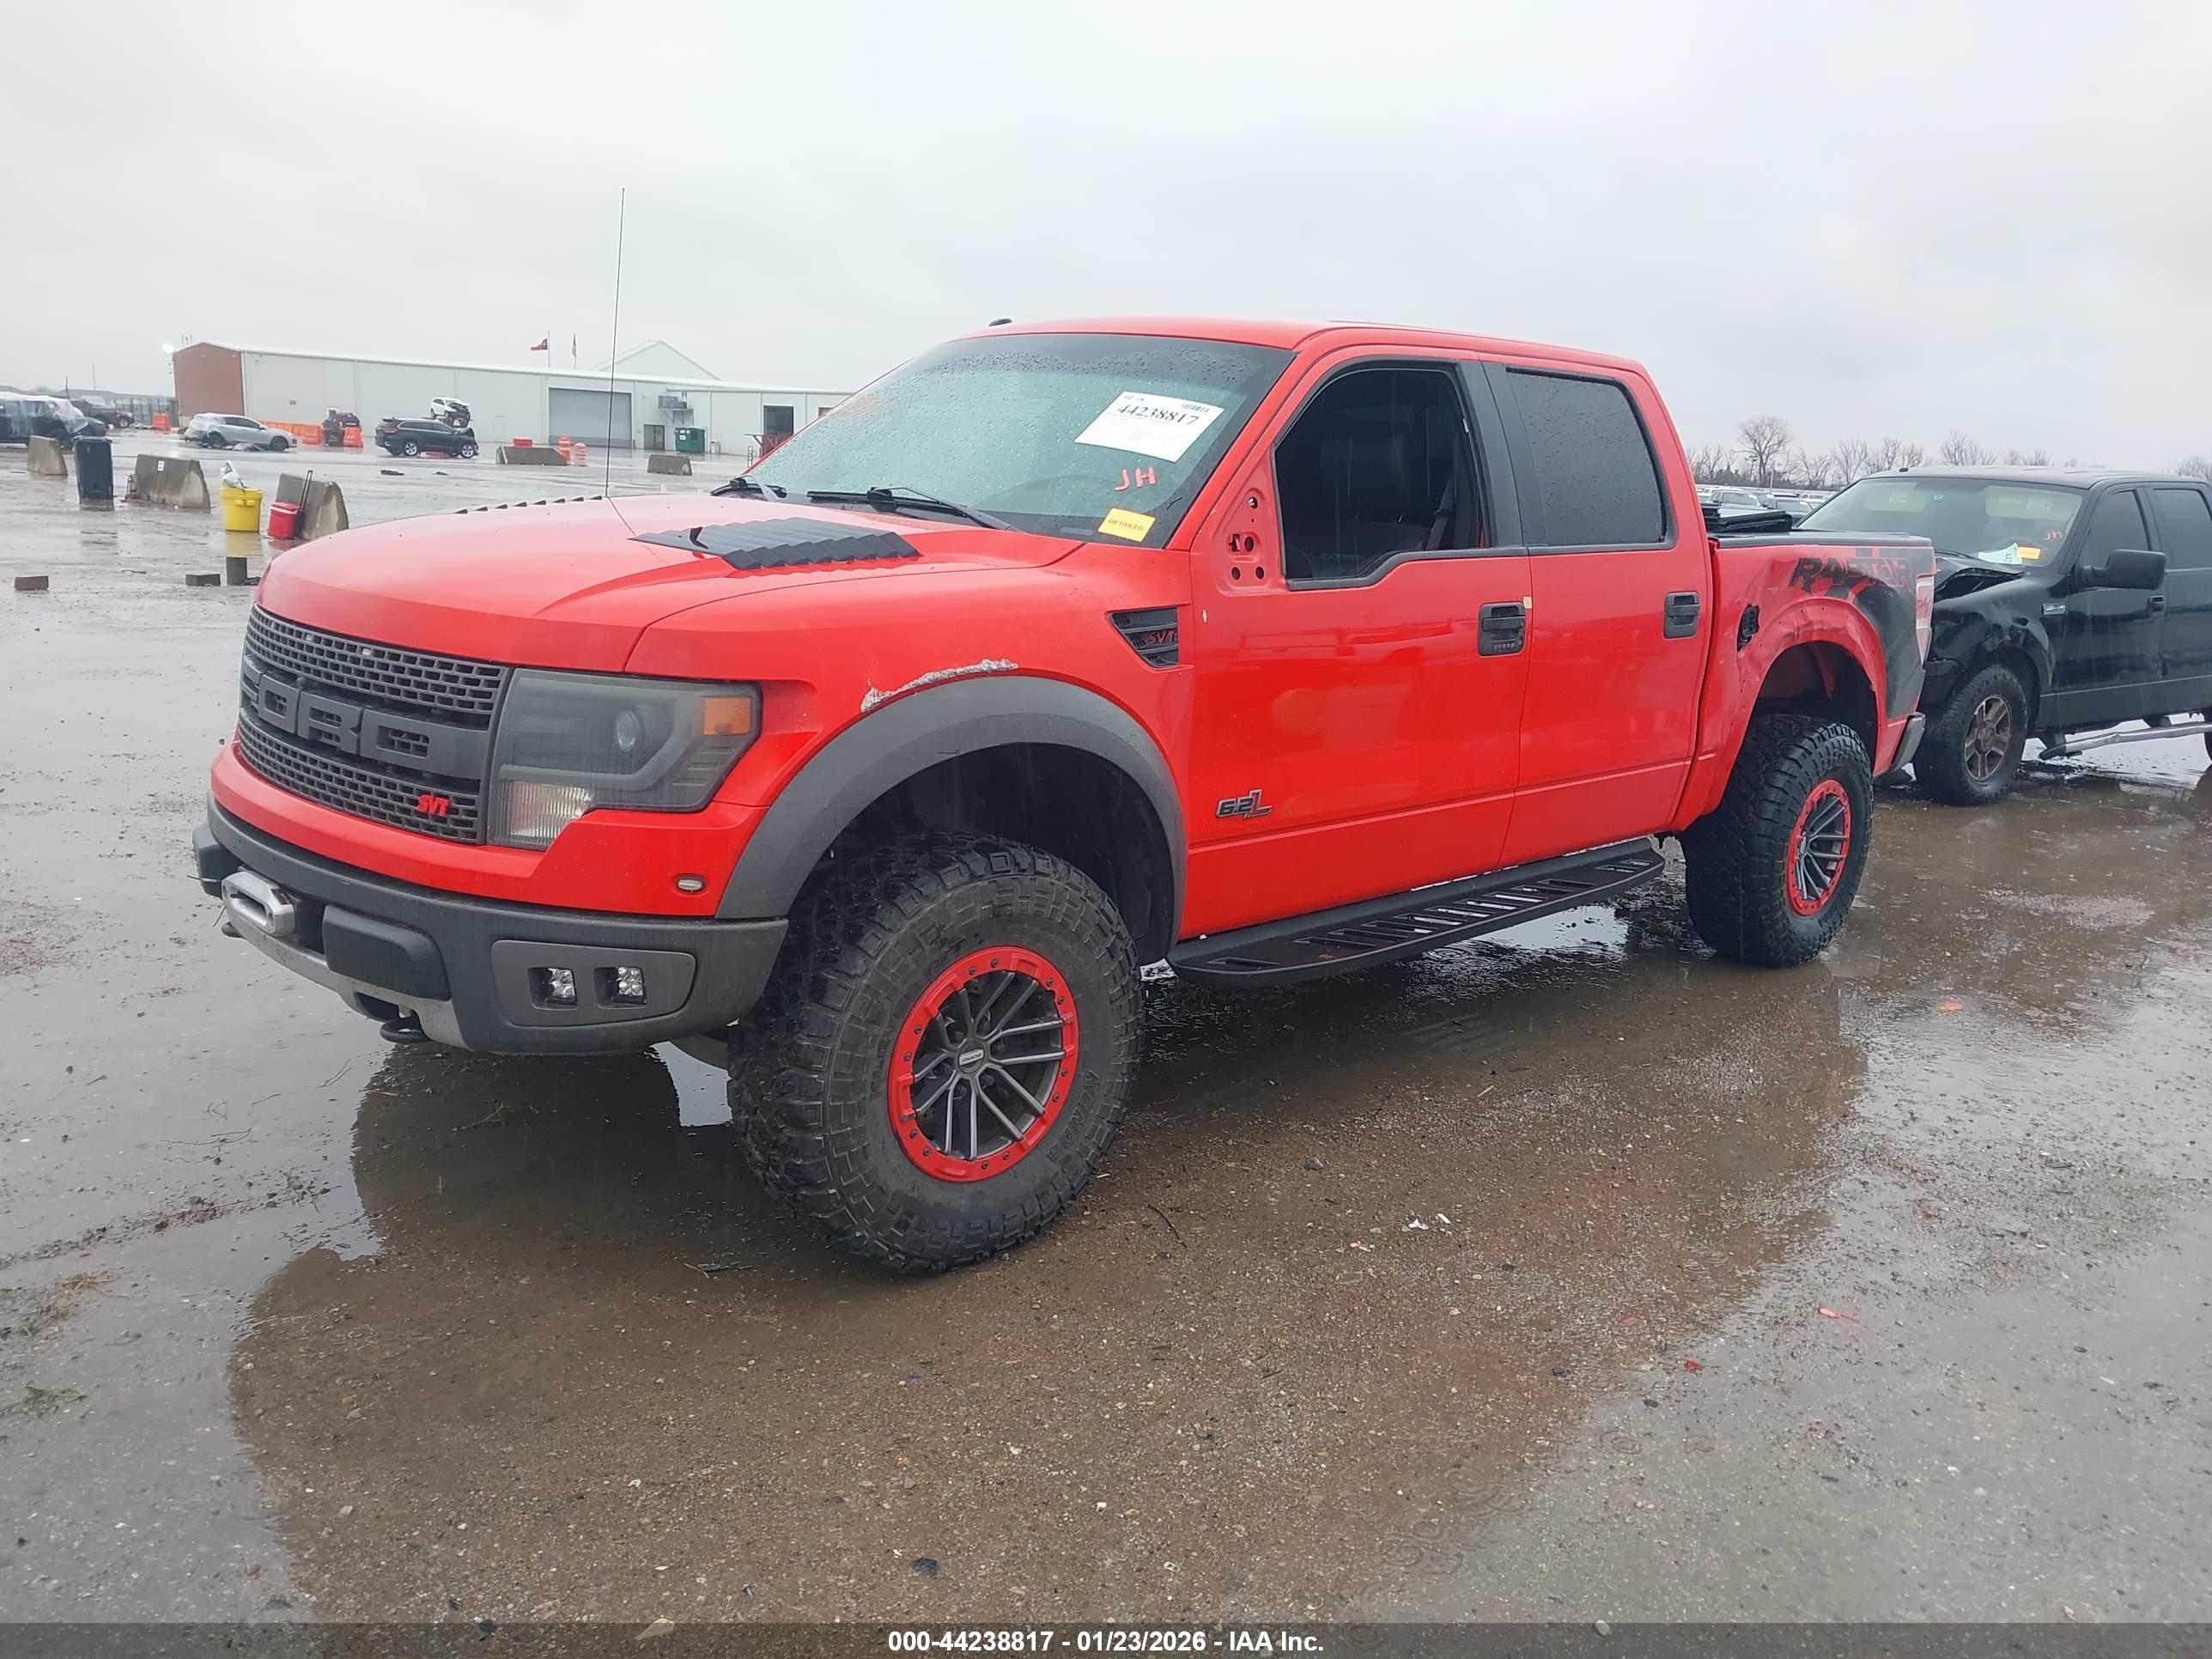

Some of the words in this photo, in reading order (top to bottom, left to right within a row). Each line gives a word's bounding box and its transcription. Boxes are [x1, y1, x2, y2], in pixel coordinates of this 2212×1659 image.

[1117, 404, 1200, 425] 44238817
[1114, 466, 1157, 492] JH
[416, 793, 450, 817] SVT
